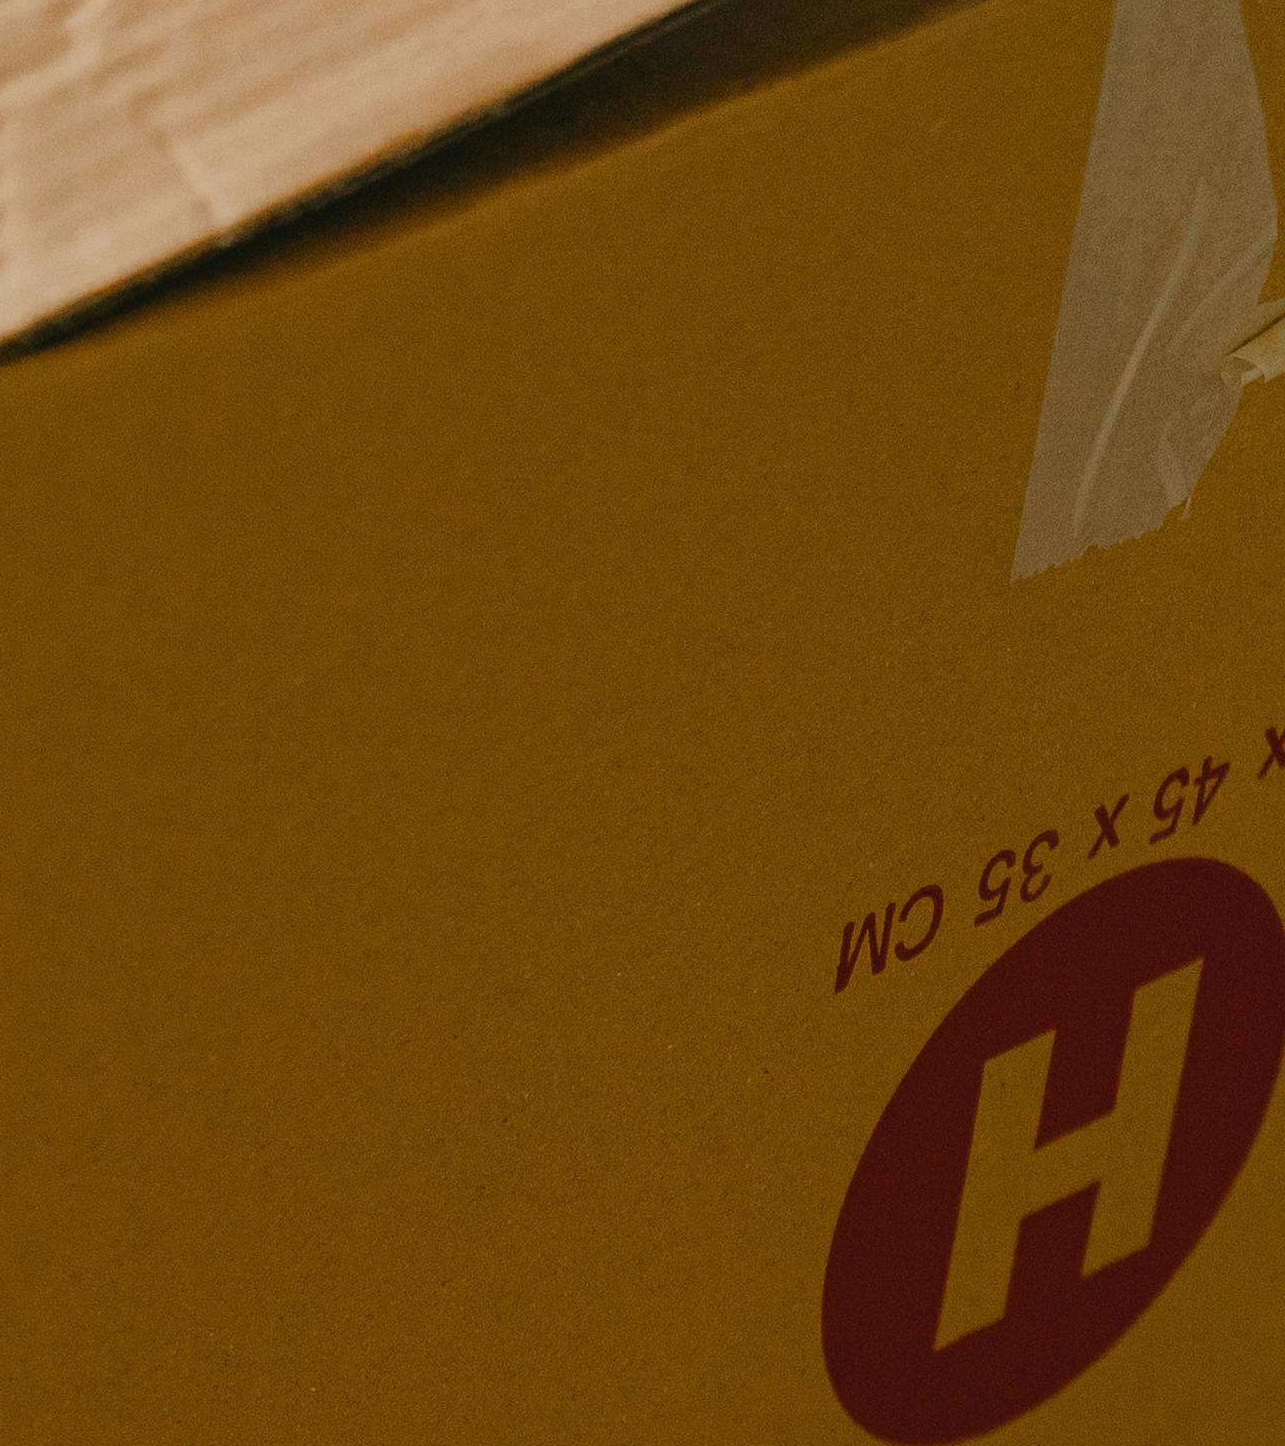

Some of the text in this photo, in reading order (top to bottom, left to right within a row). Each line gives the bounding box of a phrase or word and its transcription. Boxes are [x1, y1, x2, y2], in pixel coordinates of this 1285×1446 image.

[1150, 756, 1229, 845] 45
[975, 830, 1059, 927] 35
[834, 884, 944, 994] CM
[933, 957, 1205, 1353] H
